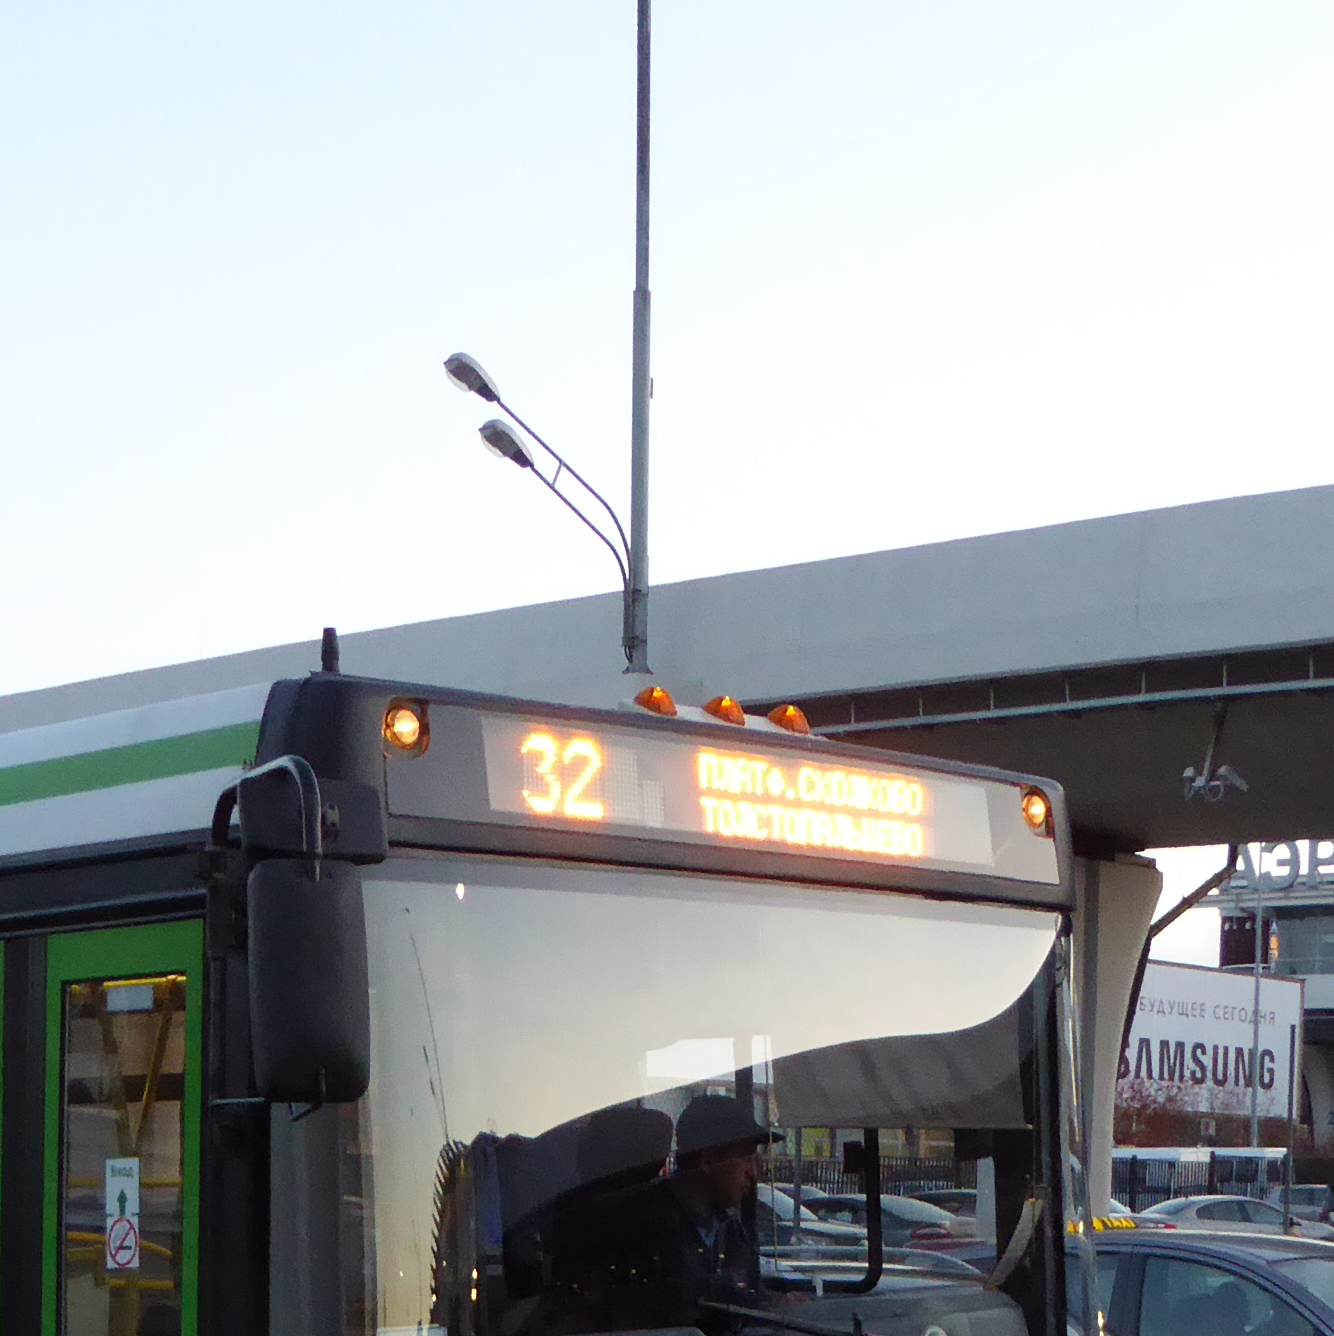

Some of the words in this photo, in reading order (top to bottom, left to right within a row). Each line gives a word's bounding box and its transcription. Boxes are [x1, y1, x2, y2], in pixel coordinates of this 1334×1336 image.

[522, 732, 604, 818] 32
[700, 796, 924, 857] ТОЛСТОПАЛЬЦЕВО
[1139, 996, 1206, 1019] БУДУЩЕЕ
[1213, 1004, 1275, 1026] СЕГОДНЯ
